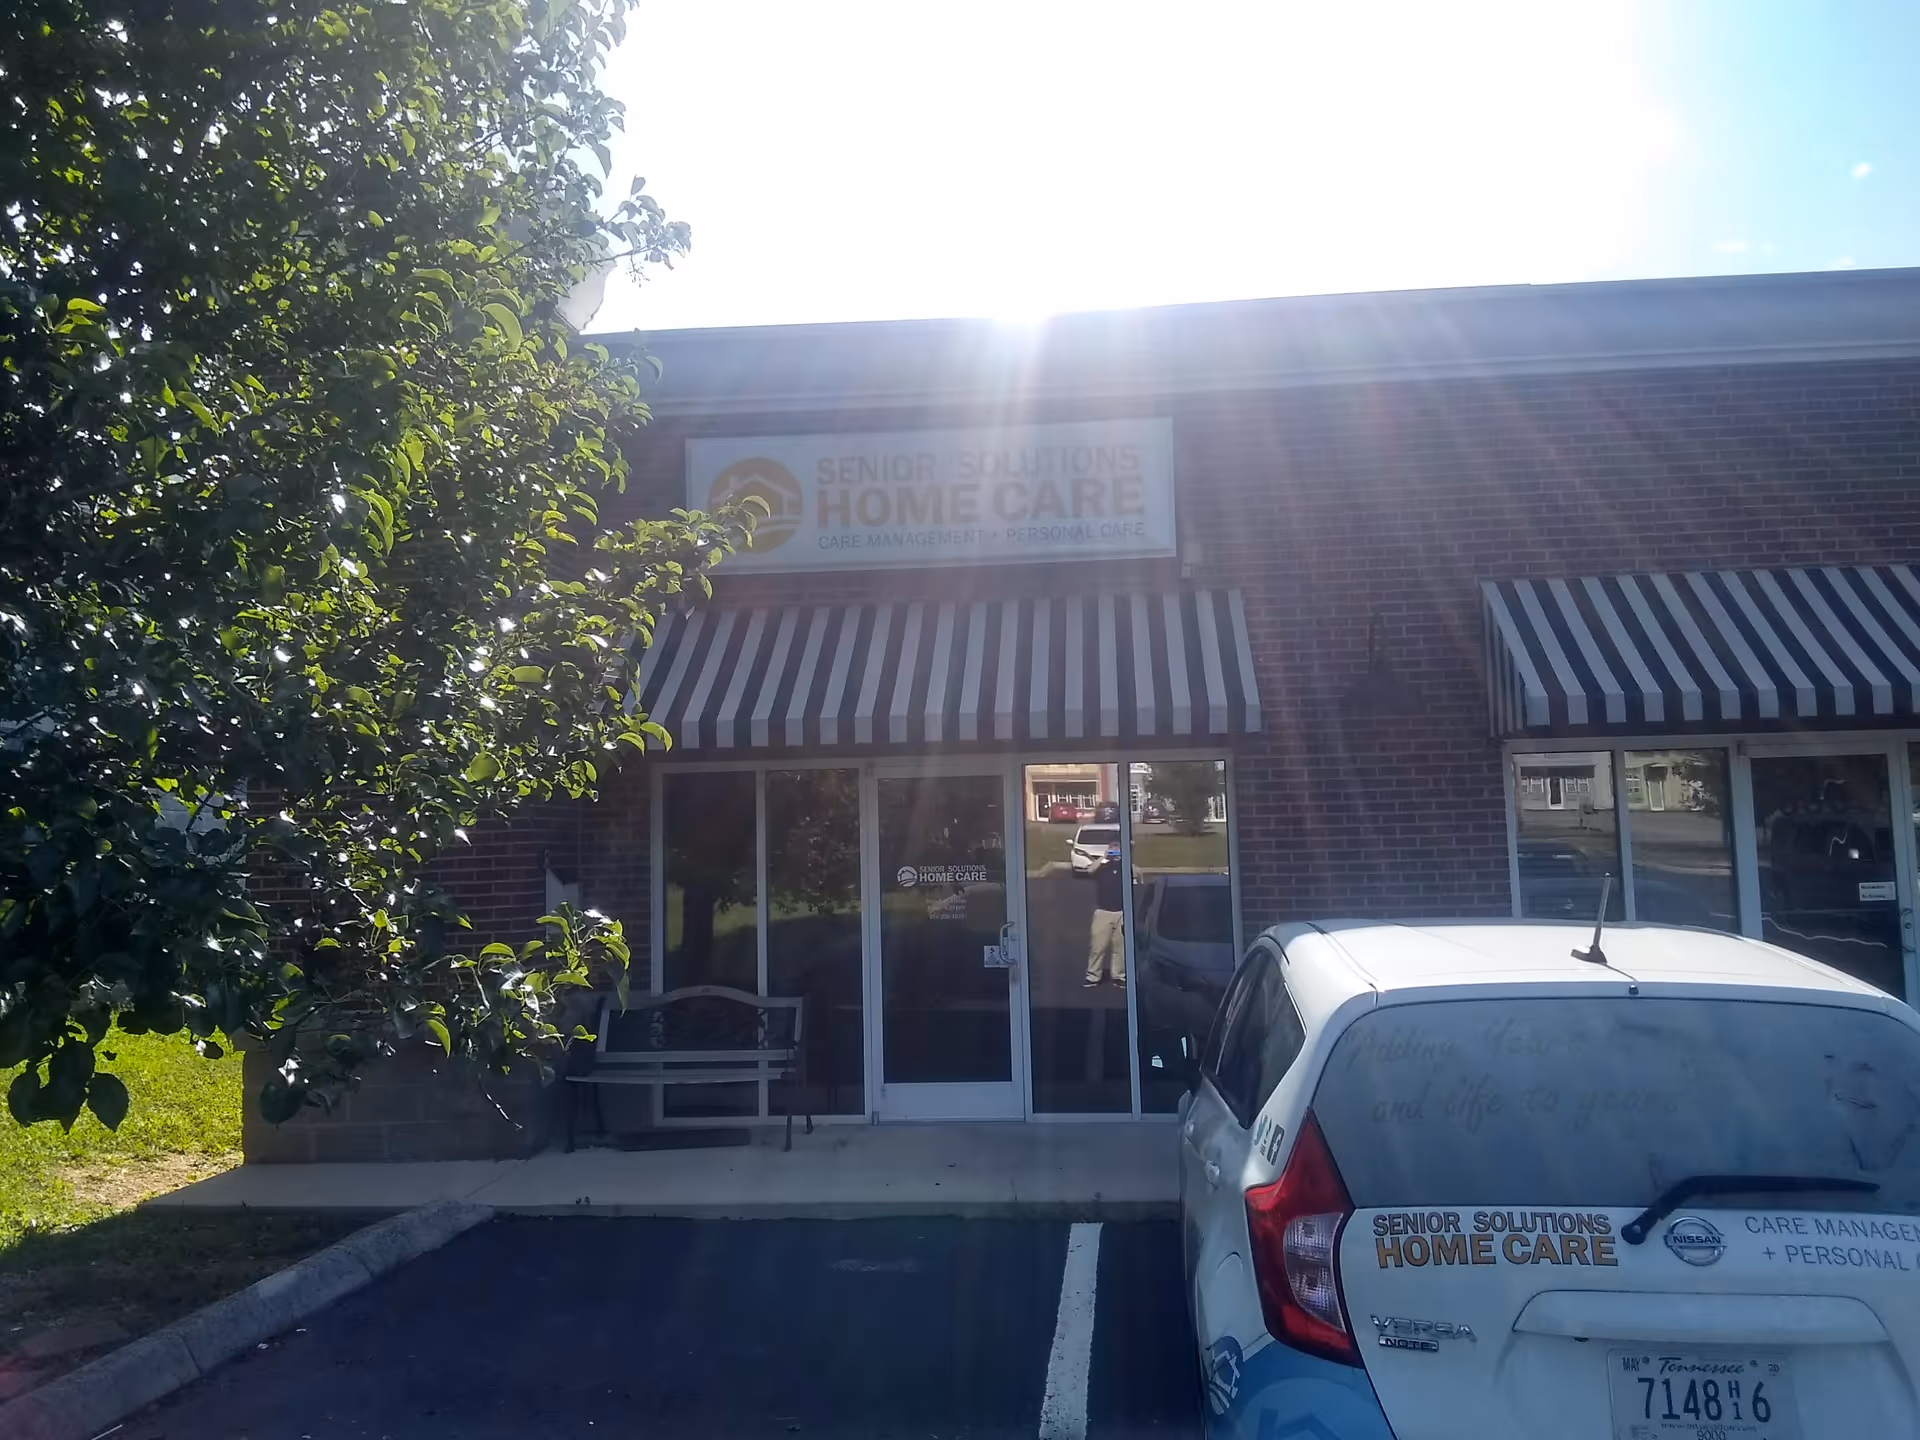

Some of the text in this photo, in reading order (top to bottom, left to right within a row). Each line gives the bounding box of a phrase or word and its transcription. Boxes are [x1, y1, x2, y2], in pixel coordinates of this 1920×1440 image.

[817, 446, 1139, 485] SENIOR SOLUTIONS
[817, 475, 1145, 529] HOME CARE
[818, 533, 865, 550] CARE
[867, 529, 985, 548] MANAGEMENT
[1006, 525, 1095, 542] PERSONAL
[1101, 521, 1146, 539] CARE
[919, 864, 987, 873] SENIOR SOLUTIONS
[919, 872, 987, 883] HOME CARE
[1371, 1080, 1432, 1123] and
[1372, 1211, 1612, 1237] SENIOR SOLUTIONS
[1744, 1215, 1809, 1235] CARE
[1375, 1233, 1620, 1269] HOME CARE
[1672, 1235, 1721, 1245] NISSAN
[1784, 1244, 1911, 1272] PERSONAL
[1370, 1314, 1478, 1343] VERSA
[1384, 1336, 1435, 1351] NOTE
[1621, 1356, 1641, 1373] MAY
[1658, 1356, 1745, 1375] Tennessee
